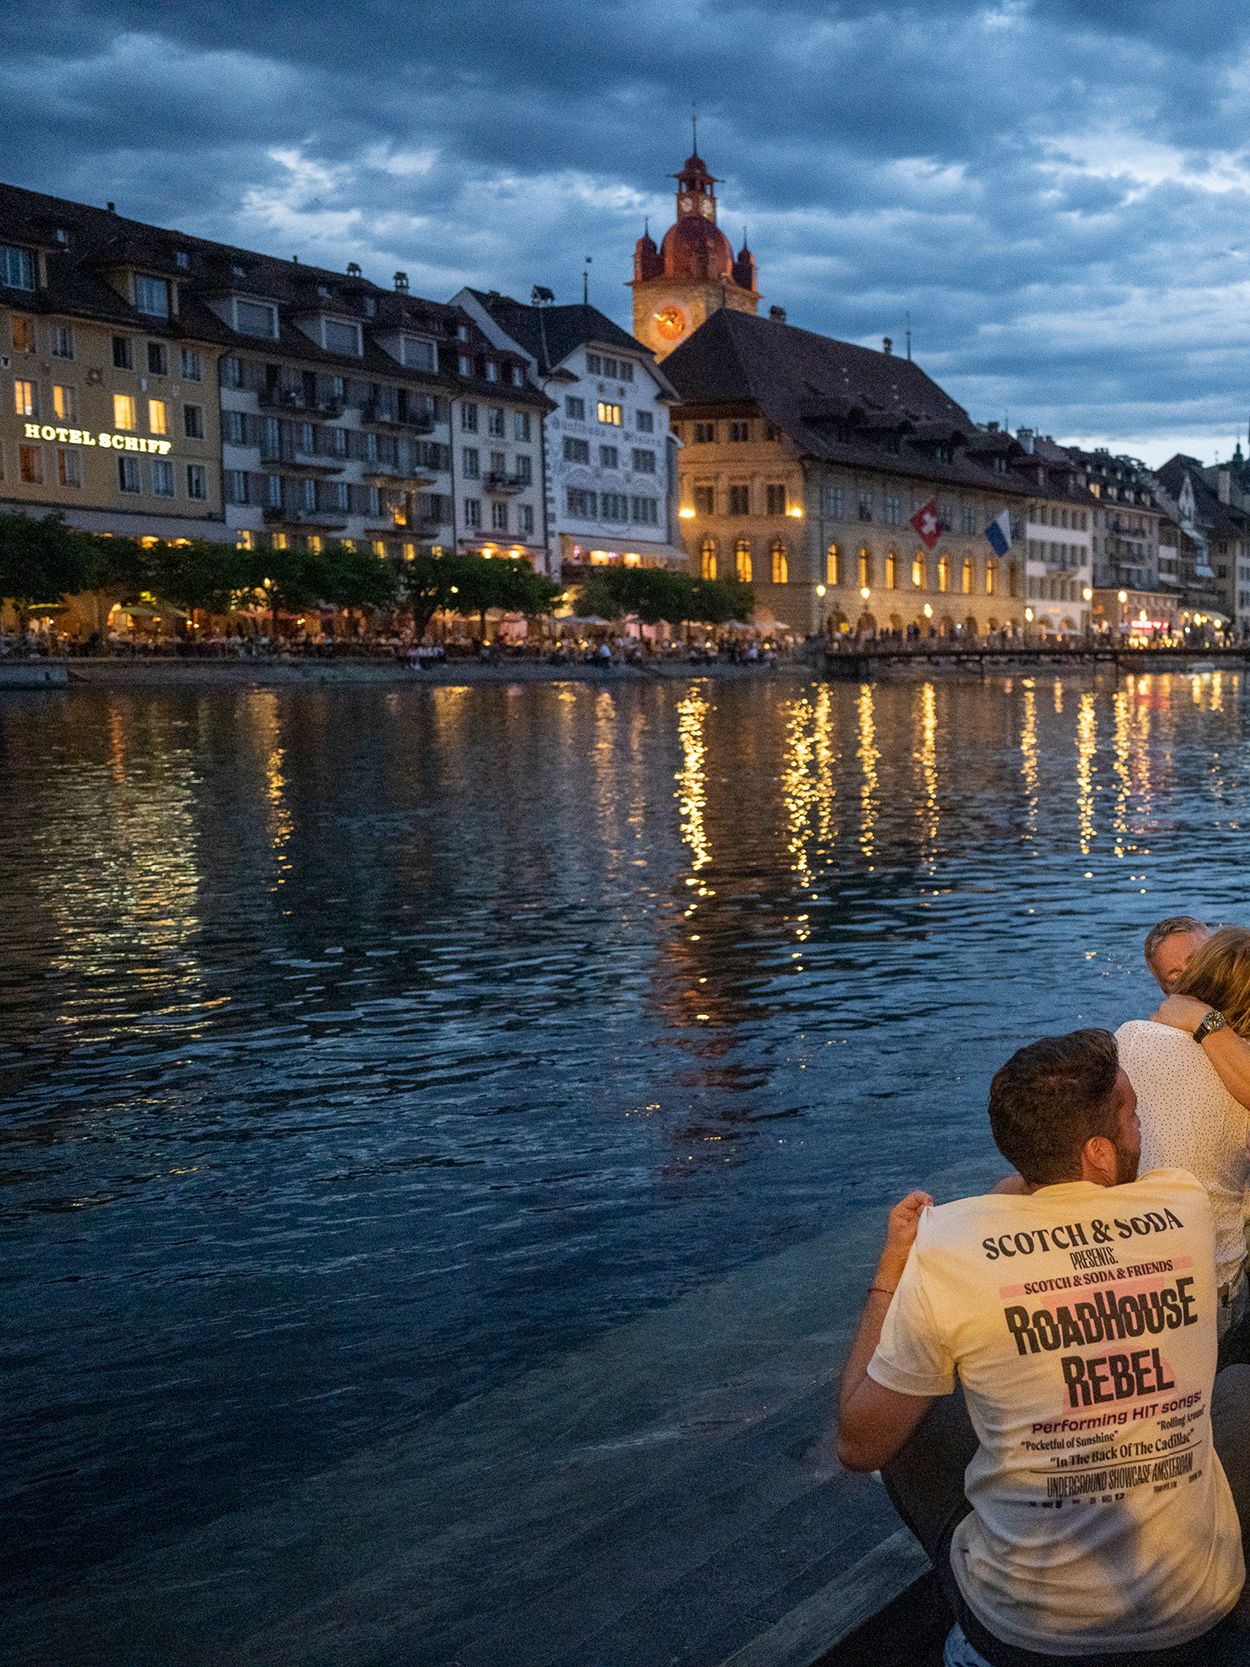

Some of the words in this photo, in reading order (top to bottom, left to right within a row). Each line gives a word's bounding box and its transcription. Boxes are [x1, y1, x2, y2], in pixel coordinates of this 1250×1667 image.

[24, 423, 96, 446] HOTEL
[98, 433, 172, 455] SCHIFF
[982, 1222, 1089, 1261] SCOTCH
[1090, 1219, 1114, 1244] &
[1113, 1207, 1184, 1239] SODA
[1069, 1246, 1119, 1271] PRESENTS:
[1024, 1276, 1072, 1295] SCOTCH
[1073, 1275, 1083, 1287] &
[1083, 1271, 1115, 1285] SODA
[1116, 1267, 1127, 1279] &
[1127, 1259, 1174, 1278] FRIENDS
[1132, 1404, 1159, 1421] HIT
[1066, 1437, 1075, 1449] of
[1070, 1453, 1090, 1466] The
[1091, 1447, 1118, 1463] Back
[1119, 1443, 1132, 1457] Of
[1132, 1442, 1153, 1455] The
[1047, 1471, 1107, 1498] UNDERGROUND
[1108, 1464, 1151, 1491] SHOWCASE
